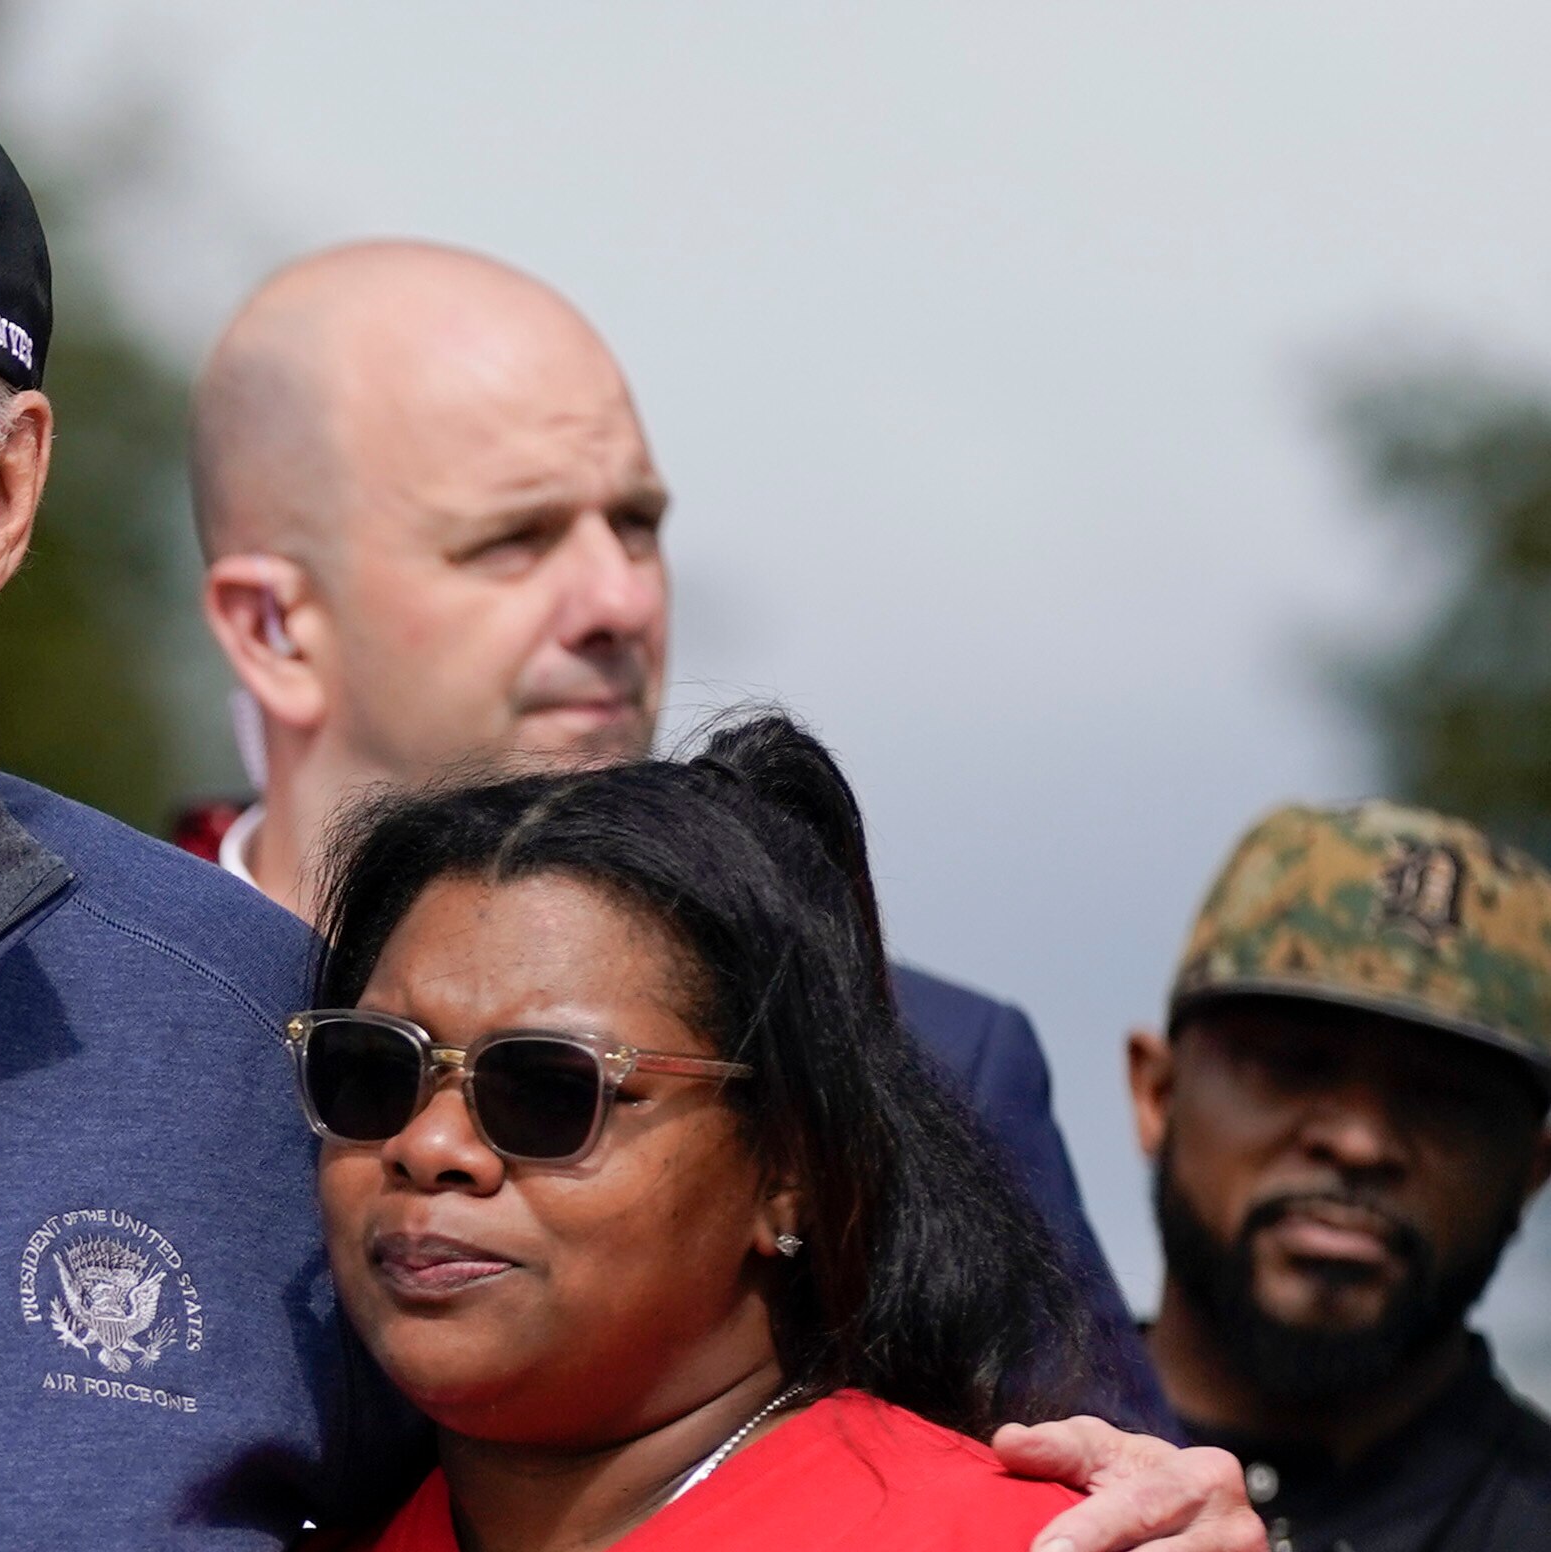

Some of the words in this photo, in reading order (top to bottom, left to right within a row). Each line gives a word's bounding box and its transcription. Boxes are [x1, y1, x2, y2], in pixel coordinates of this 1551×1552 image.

[20, 1215, 60, 1325] PRESIDENT
[63, 1211, 79, 1226] OF
[78, 1209, 107, 1222] THE
[110, 1209, 183, 1270] UNITED
[177, 1272, 206, 1353] STATES
[43, 1373, 78, 1393] AIR
[83, 1377, 153, 1404] FORCE
[154, 1390, 198, 1413] ONE
